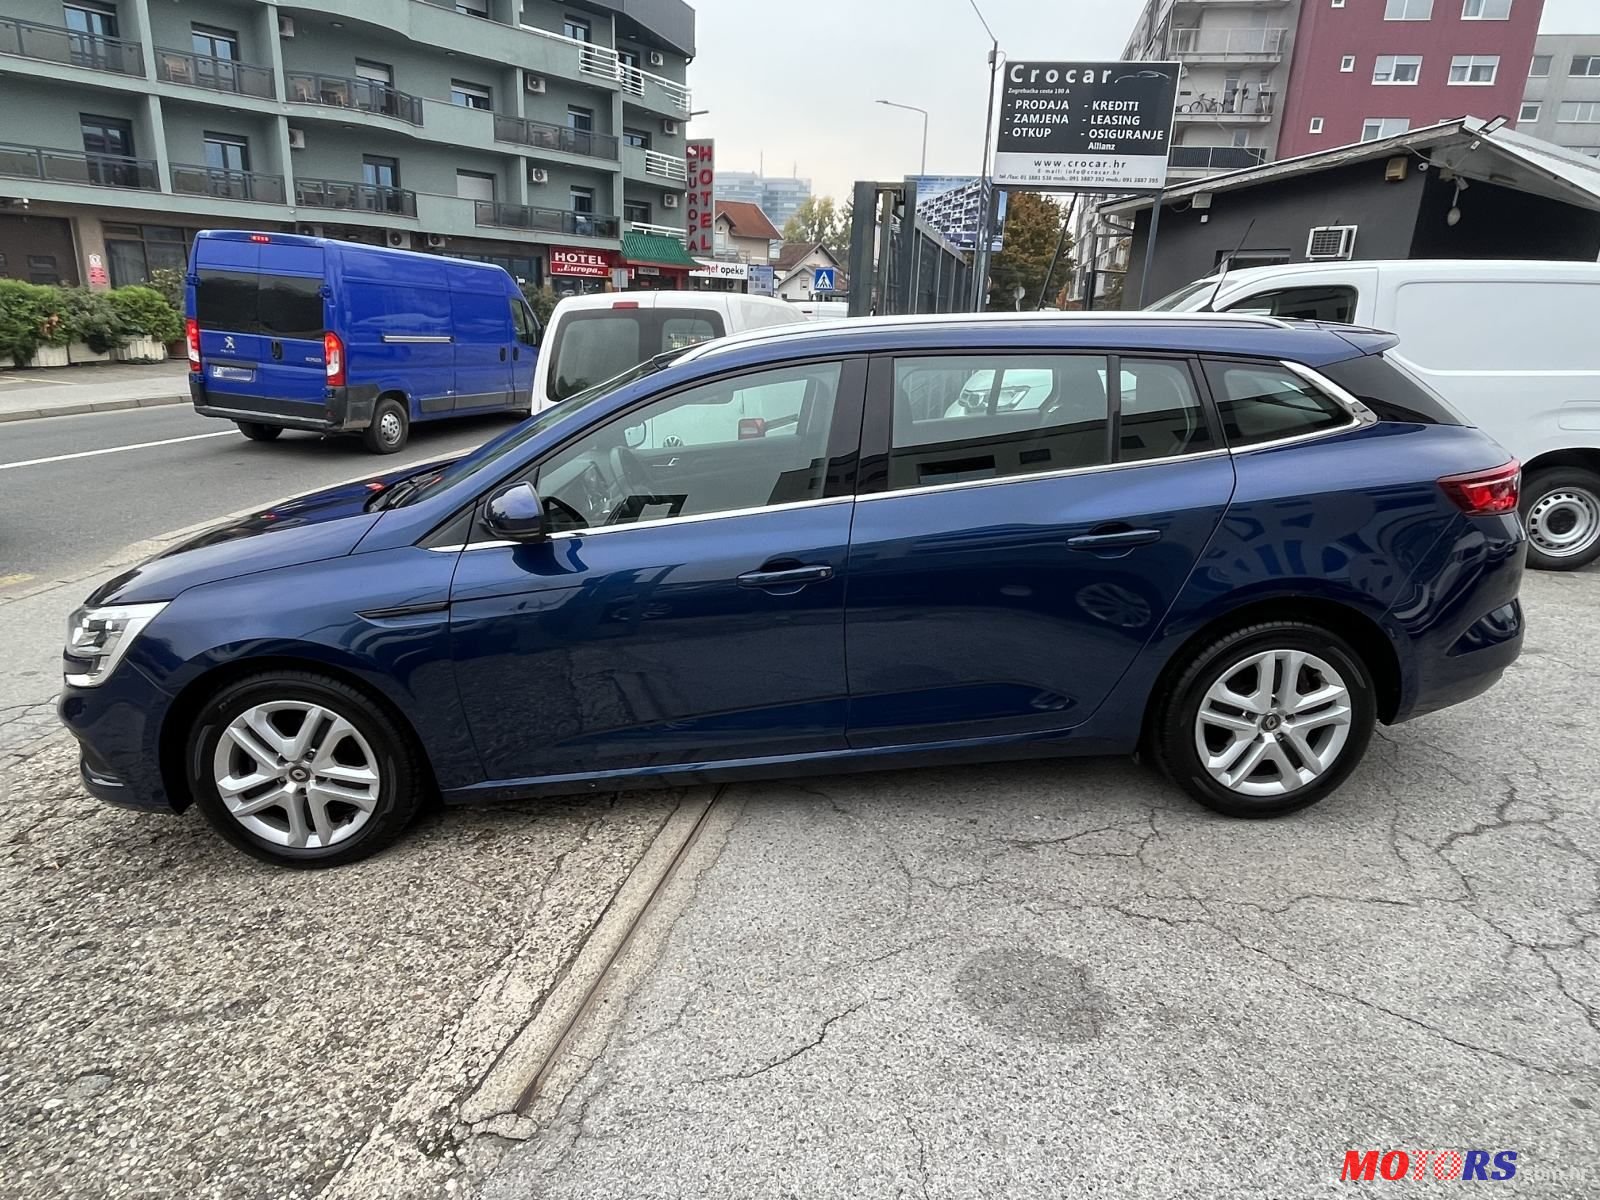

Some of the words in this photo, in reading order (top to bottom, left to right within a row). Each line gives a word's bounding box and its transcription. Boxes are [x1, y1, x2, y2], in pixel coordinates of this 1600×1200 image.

[1010, 64, 1112, 84] Crocar
[1015, 99, 1070, 110] PRODAJA
[1092, 100, 1140, 111] KREDITI
[1013, 113, 1069, 124] ZAMJENA
[1090, 114, 1141, 126] LEASING
[1012, 127, 1052, 138] OTKUP
[1088, 128, 1164, 140] OSIGURANJE
[1087, 141, 1116, 151] Allianz
[1033, 160, 1126, 169] www.crocar.hr
[699, 145, 713, 251] HOTEL
[688, 161, 698, 252] EUROPA
[554, 252, 606, 265] HOTEL
[720, 265, 745, 276] opeke
